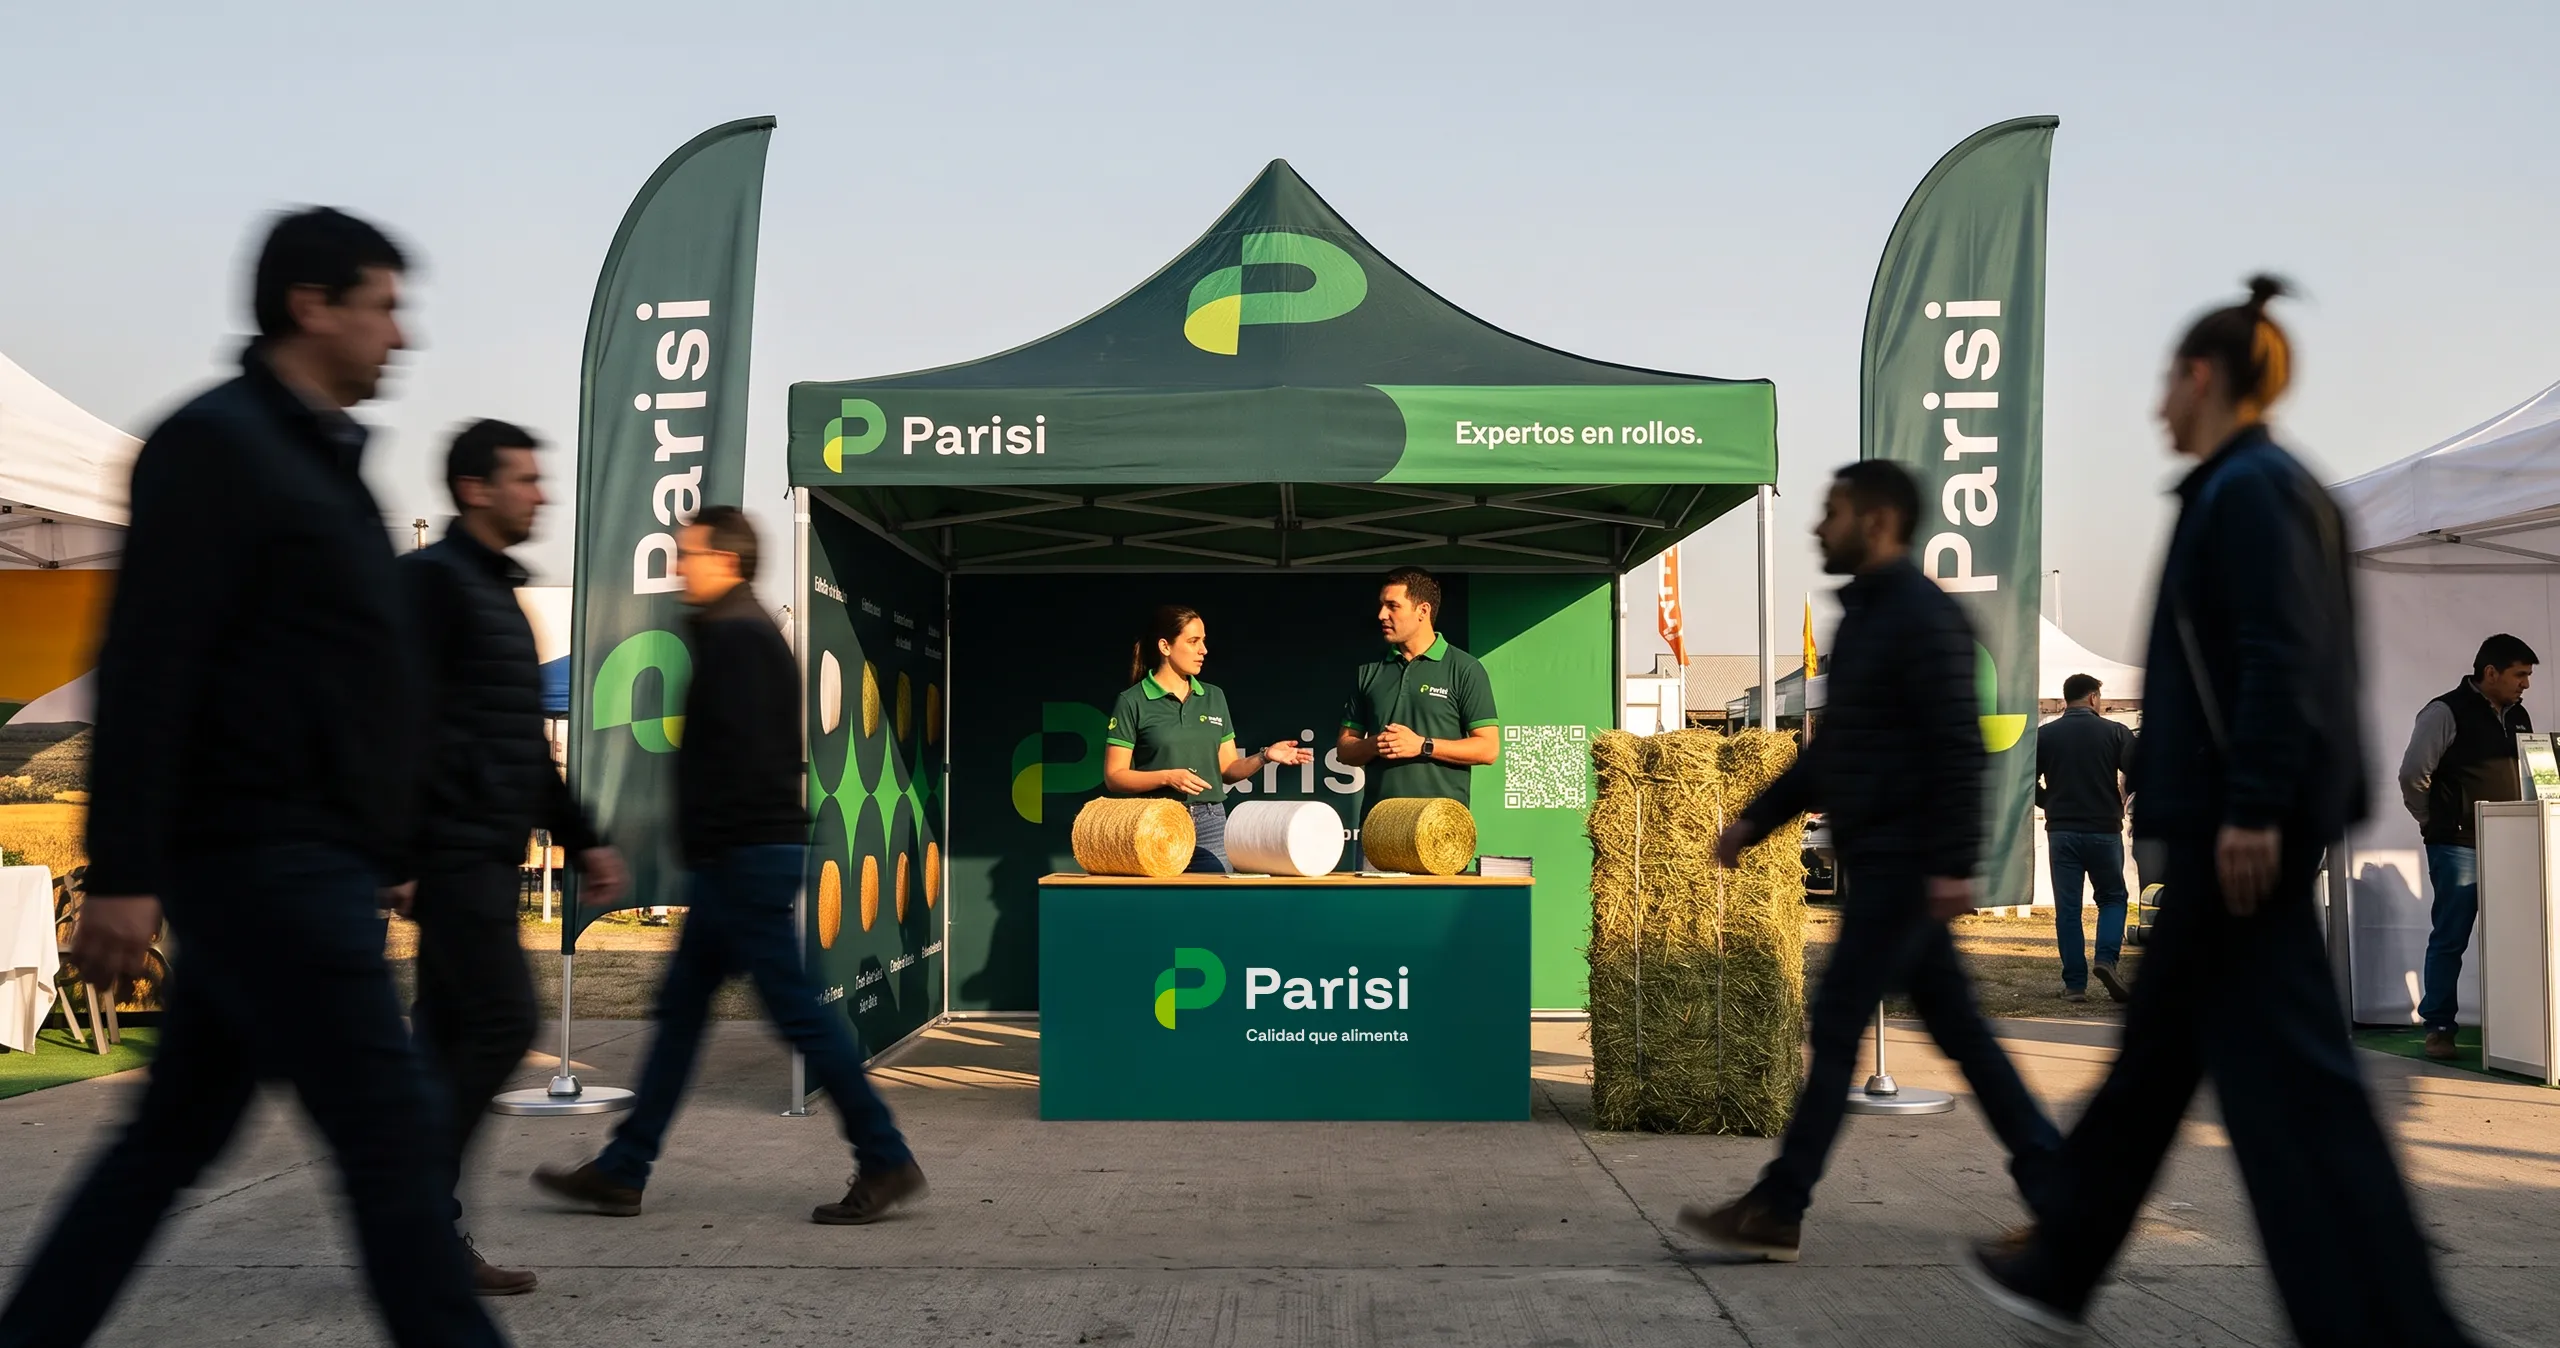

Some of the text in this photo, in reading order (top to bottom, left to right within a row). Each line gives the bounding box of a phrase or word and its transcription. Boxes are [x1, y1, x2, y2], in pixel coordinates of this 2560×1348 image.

[633, 299, 711, 595] Parisi
[903, 414, 1046, 456] Parisi
[1456, 420, 1704, 450] Expertos en rollos.
[1923, 300, 2001, 594] Parisi
[1246, 965, 1409, 1011] Parisi
[1246, 1028, 1409, 1045] Calidad que alimenta
